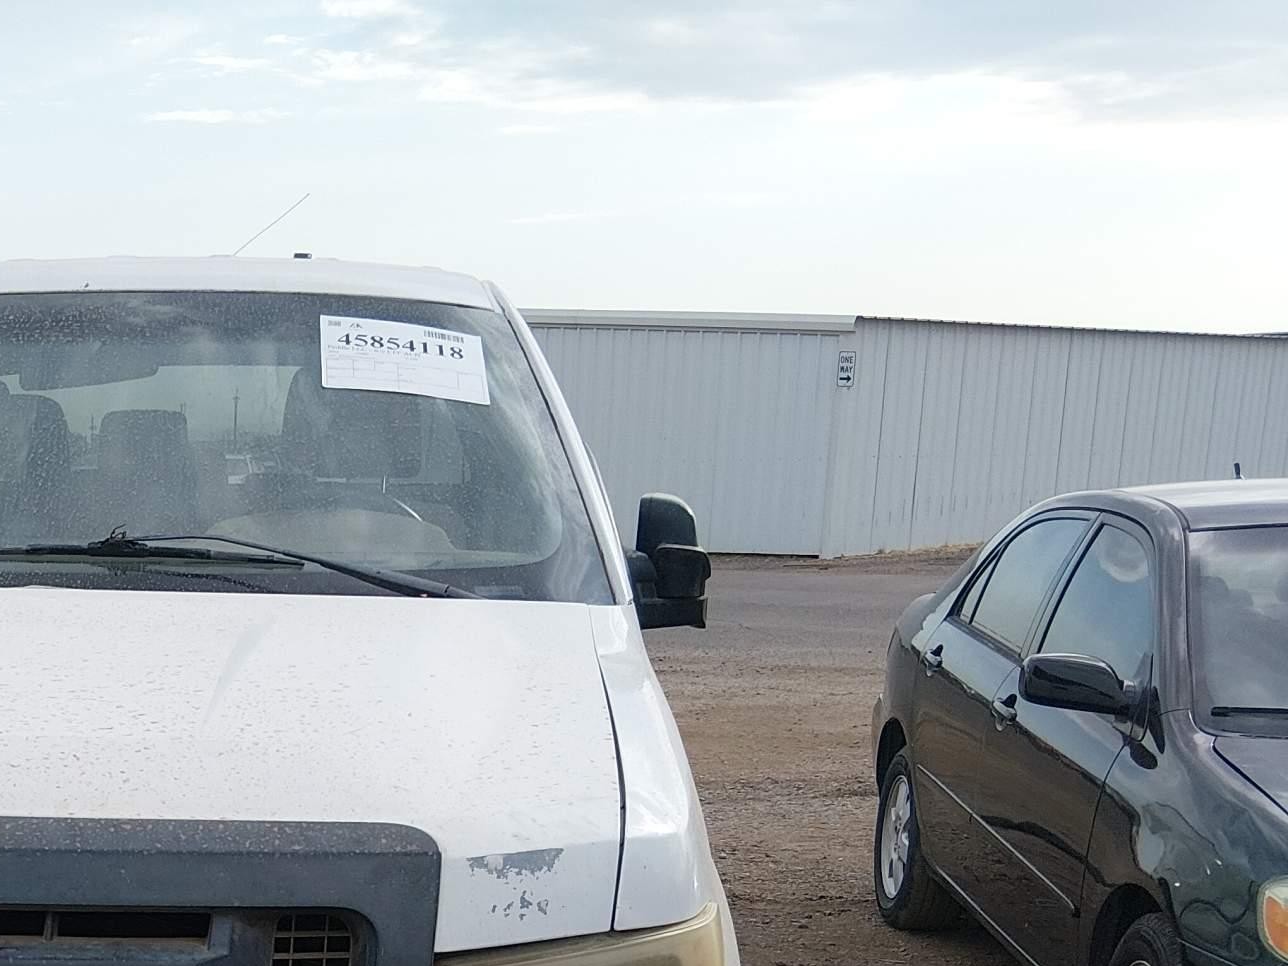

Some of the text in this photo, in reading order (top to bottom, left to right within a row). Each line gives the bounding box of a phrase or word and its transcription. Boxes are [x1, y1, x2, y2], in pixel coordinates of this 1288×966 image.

[337, 332, 464, 360] 45854118
[840, 355, 854, 364] ONE
[839, 365, 853, 374] WAY
